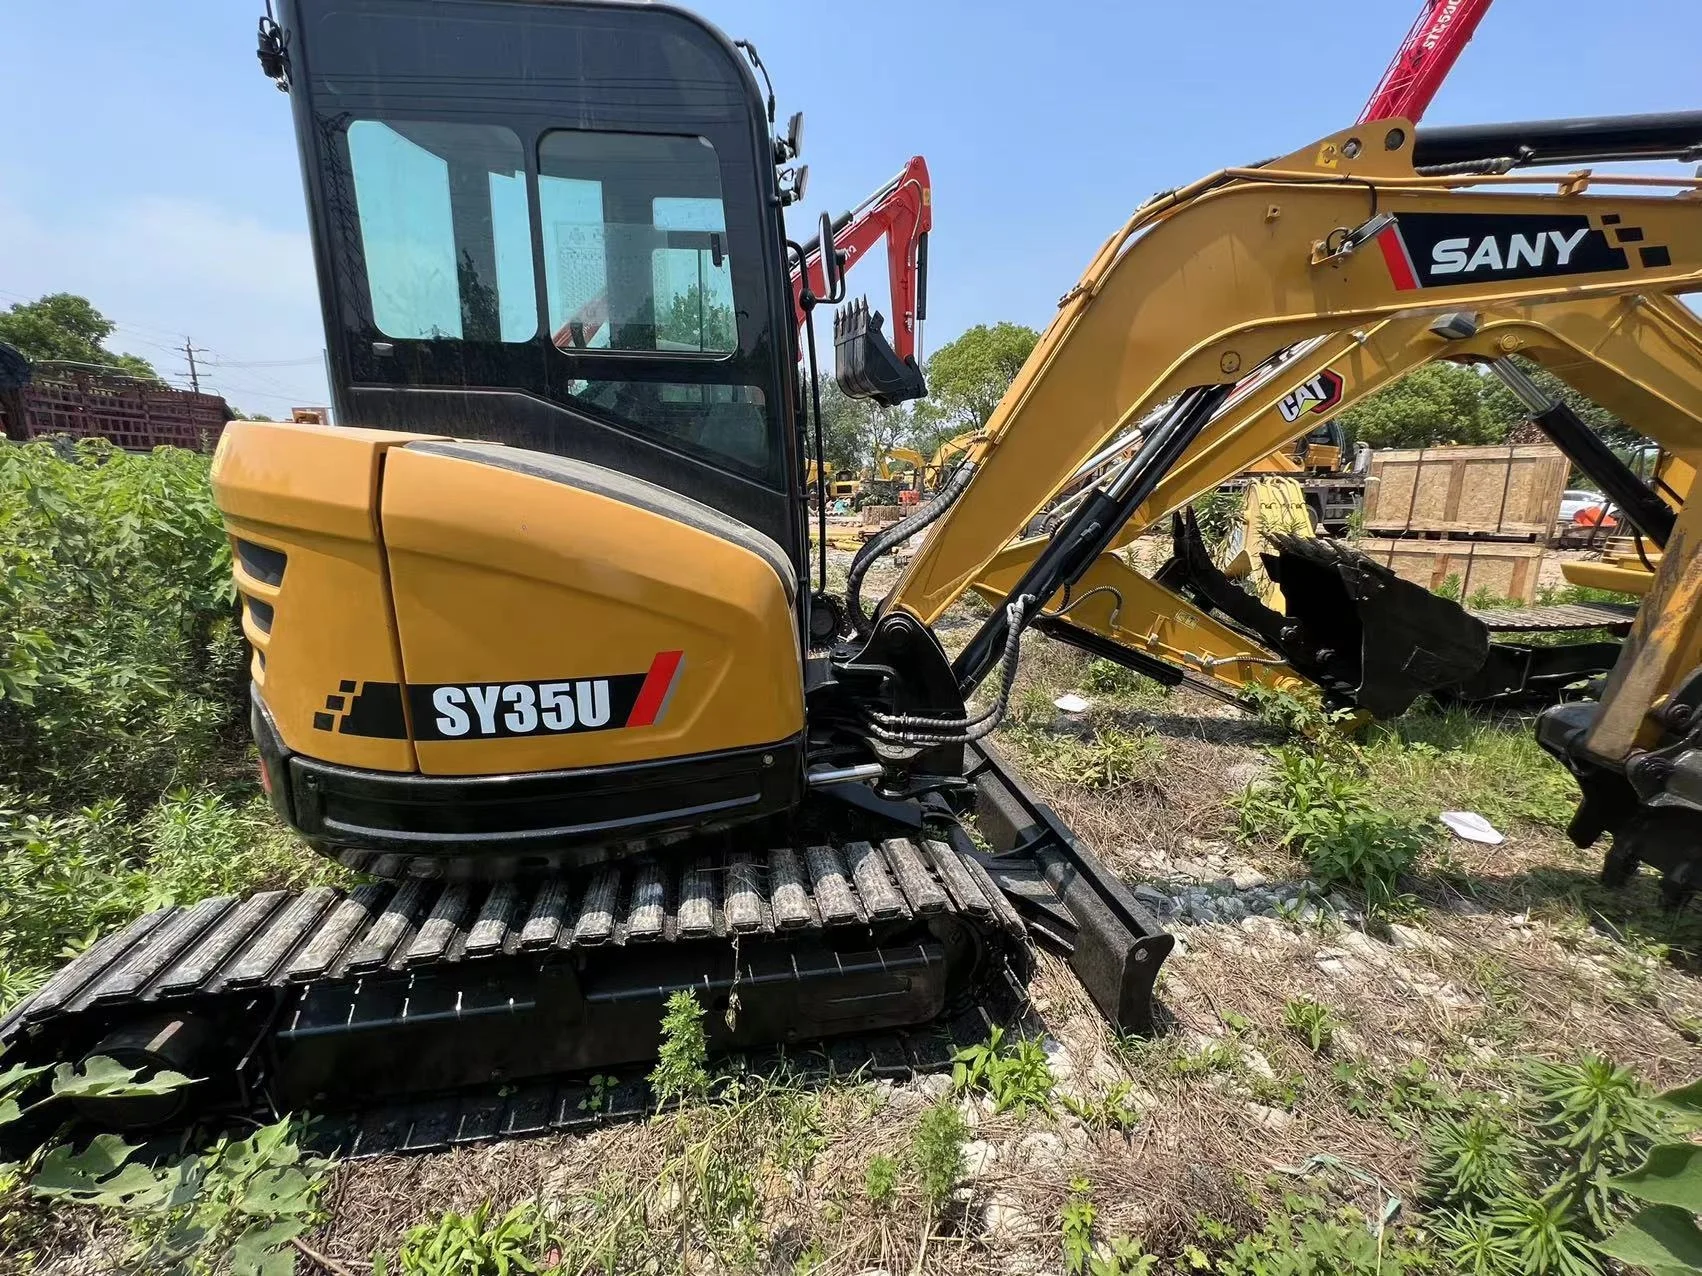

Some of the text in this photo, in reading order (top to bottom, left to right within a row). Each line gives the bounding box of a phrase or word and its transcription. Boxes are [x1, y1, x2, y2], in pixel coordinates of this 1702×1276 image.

[1430, 228, 1589, 275] SANY
[1277, 374, 1327, 421] CAT
[432, 679, 611, 736] SY35U
